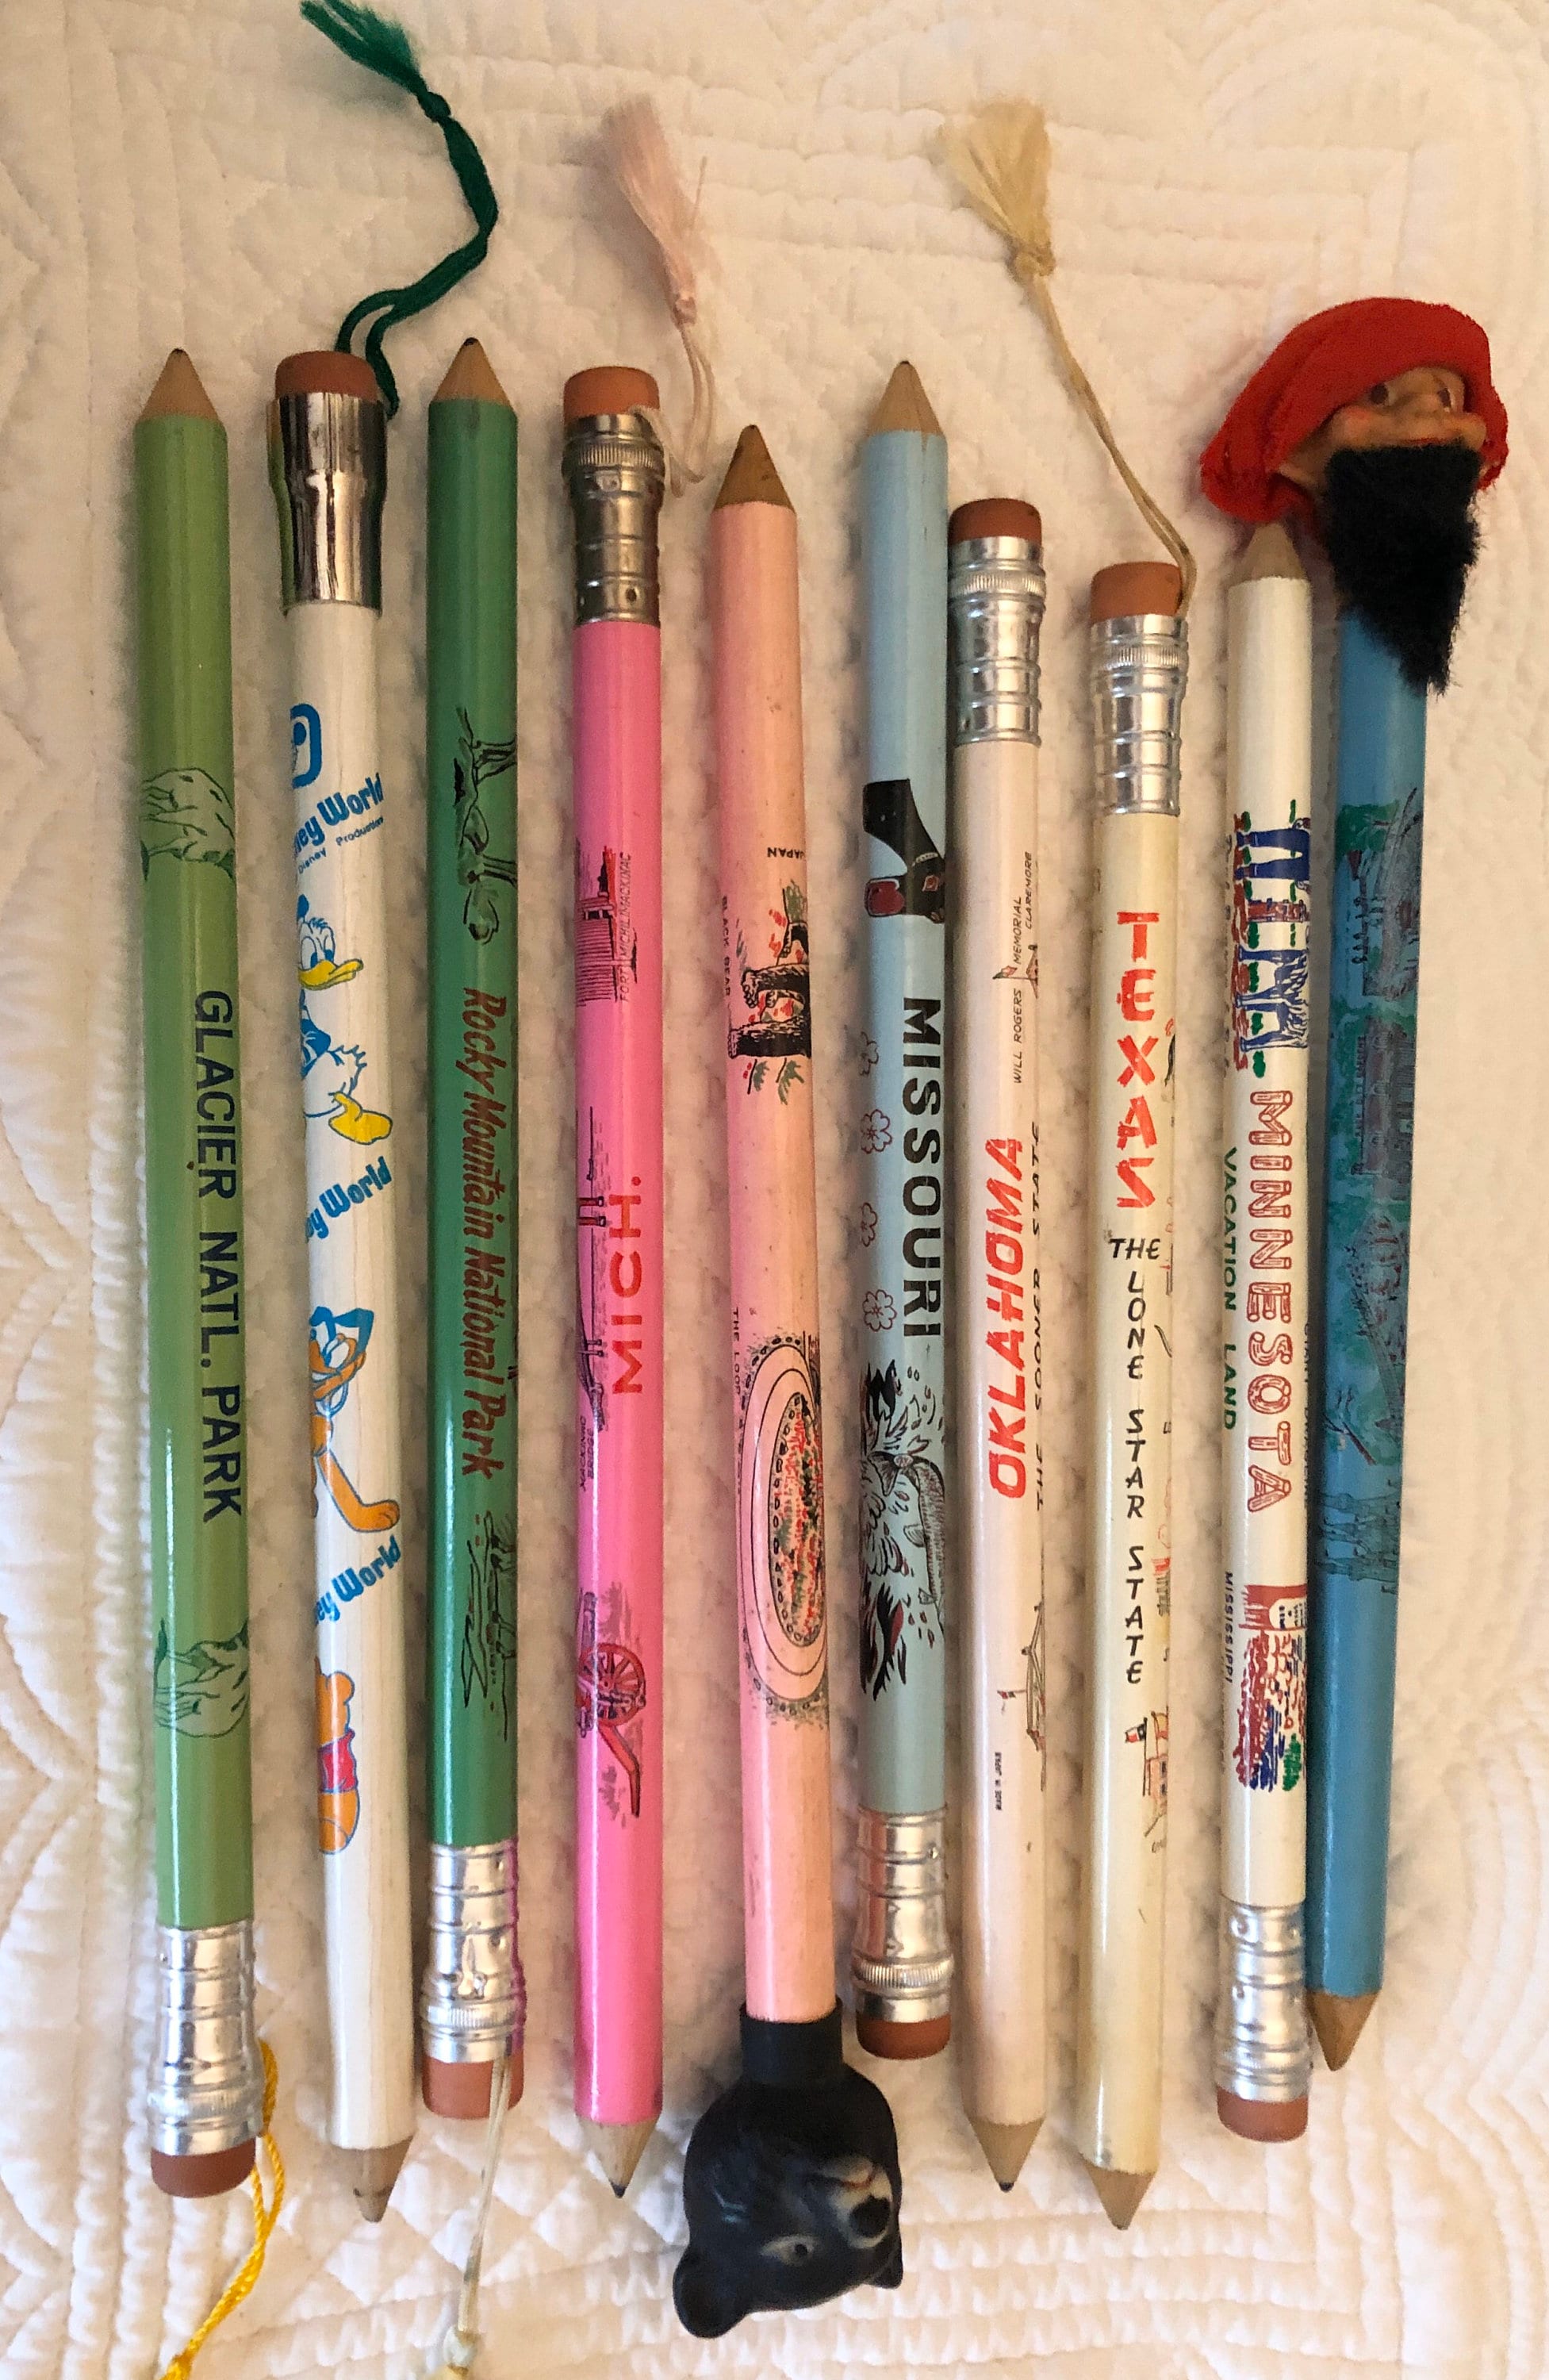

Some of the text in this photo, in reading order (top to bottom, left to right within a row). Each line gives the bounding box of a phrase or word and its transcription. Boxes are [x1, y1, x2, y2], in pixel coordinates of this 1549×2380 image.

[317, 772, 384, 826] World
[767, 846, 807, 859] JAPAN
[1024, 851, 1034, 930] CLAREMORE
[721, 896, 730, 948] BLACK
[1011, 896, 1024, 1084] WILL ROGERS MEMORIAL
[903, 997, 942, 1339] MISSOURI
[1117, 912, 1160, 1209] TEXAS
[194, 990, 242, 1523] GLACIER NATL. PARK
[319, 1155, 393, 1218] World
[455, 987, 508, 1480] Rocky Mountain National Park
[609, 1176, 642, 1395] MICH.
[1223, 1147, 1237, 1430] VACATION LAND
[986, 1138, 1026, 1499] OKLAHOMA
[1248, 1089, 1294, 1513] MINNESOTA
[332, 1534, 401, 1603] World
[1110, 1238, 1161, 1685] THE LONE STAR STATE
[1224, 1572, 1234, 1684] MISSISSIPPI
